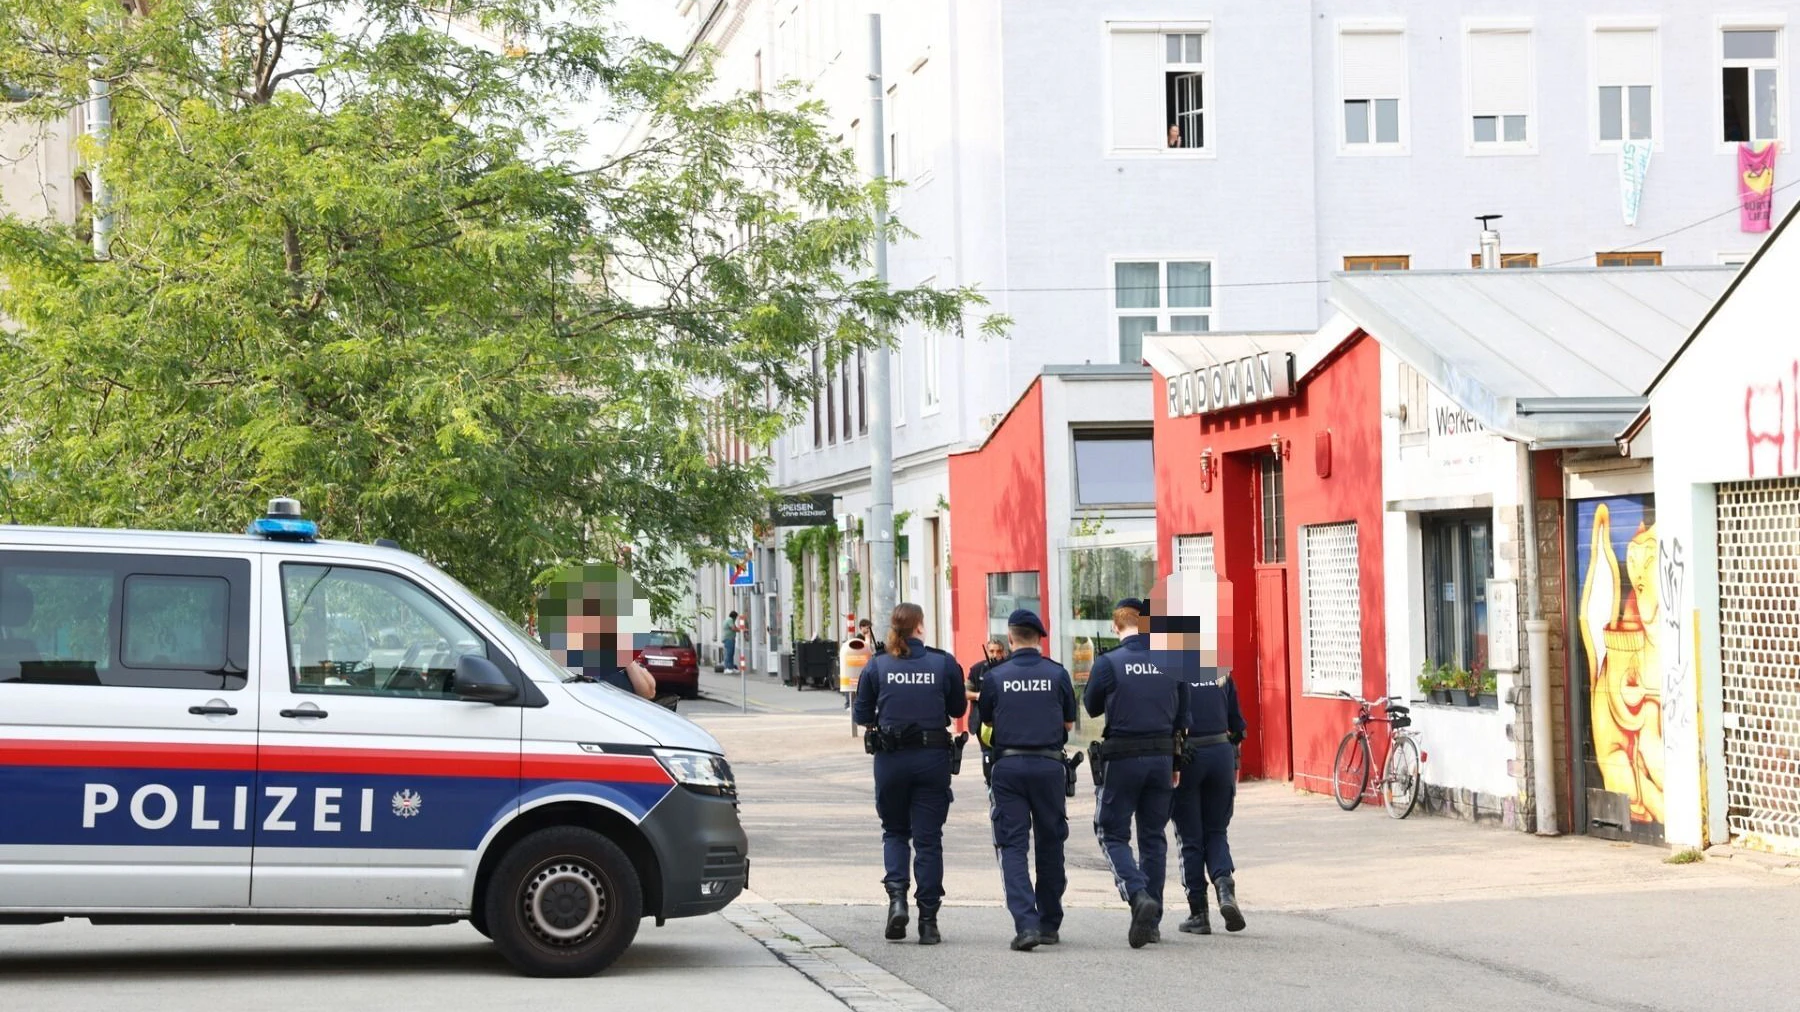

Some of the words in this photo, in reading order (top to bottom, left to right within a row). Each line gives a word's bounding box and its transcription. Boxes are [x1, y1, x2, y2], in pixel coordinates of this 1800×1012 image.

[1169, 354, 1272, 413] RADOWAN
[887, 672, 935, 685] POLIZEI
[1003, 679, 1052, 692] POLIZEI
[83, 783, 374, 833] POLIZEI
